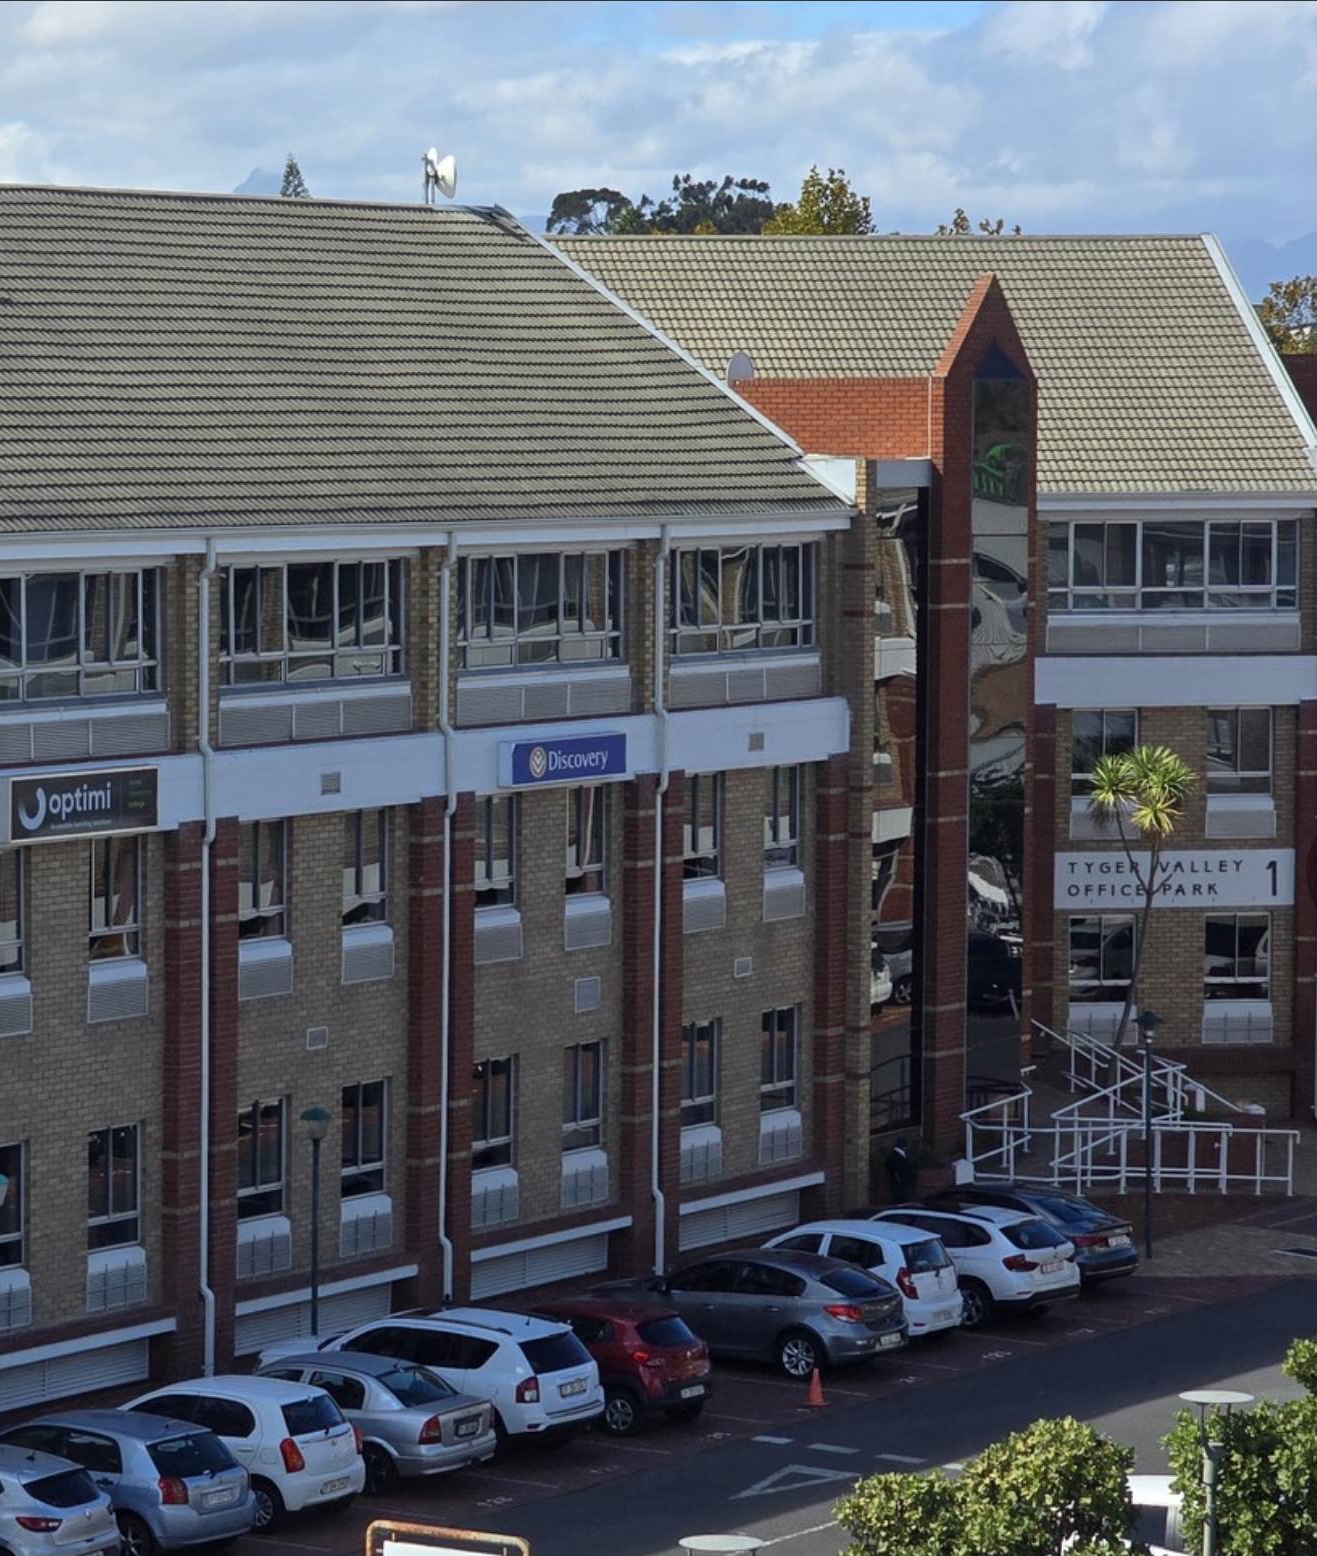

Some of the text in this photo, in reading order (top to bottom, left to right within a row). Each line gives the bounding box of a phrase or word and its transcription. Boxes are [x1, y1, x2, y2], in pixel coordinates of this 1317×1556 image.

[548, 750, 609, 771] Discovery
[49, 782, 111, 820] optimi
[1068, 860, 1244, 874] TYGER VALLEY
[1266, 860, 1279, 897] 1
[1067, 882, 1219, 897] OFFICE PARK
